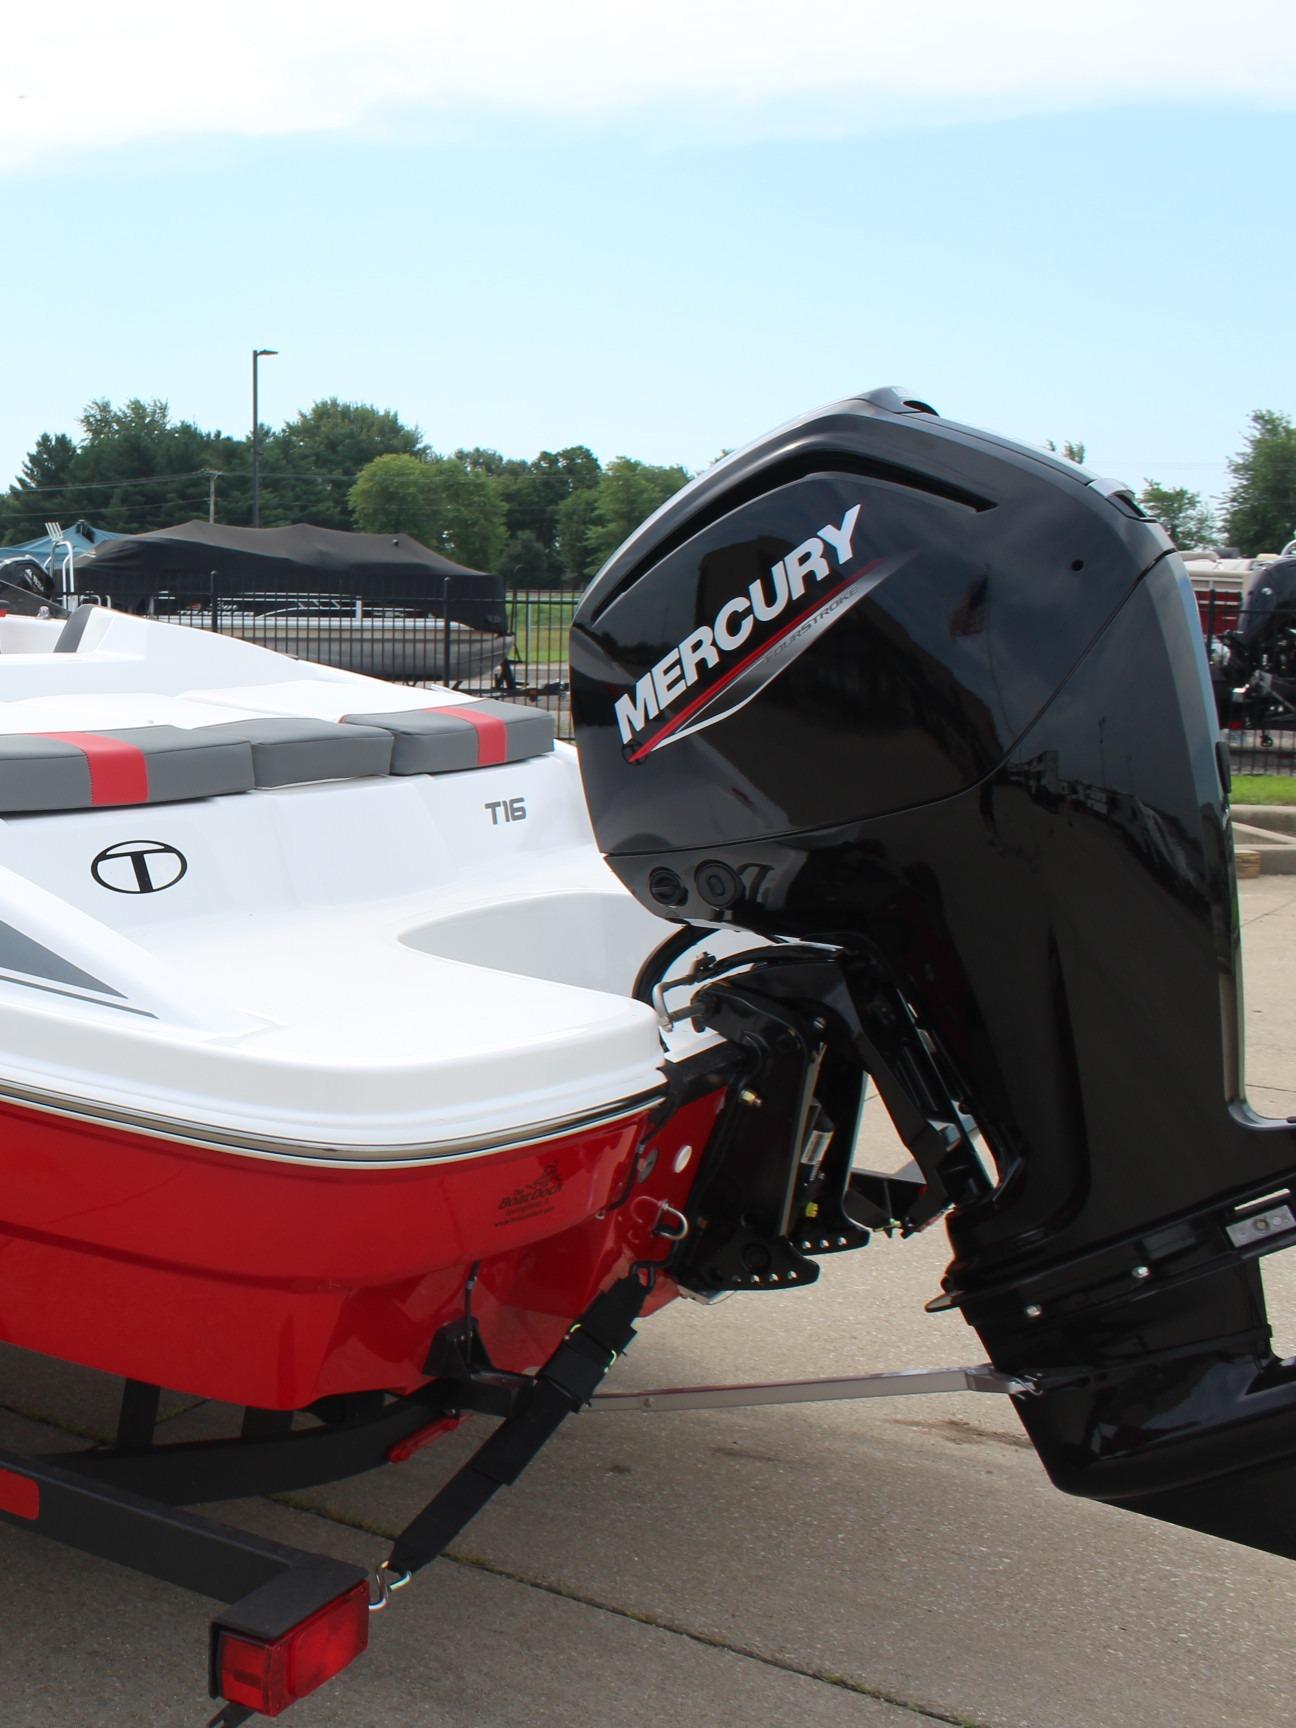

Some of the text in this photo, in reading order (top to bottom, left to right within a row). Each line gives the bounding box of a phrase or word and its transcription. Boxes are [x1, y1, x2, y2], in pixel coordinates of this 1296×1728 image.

[614, 503, 862, 744] MERCURY
[763, 584, 858, 664] FOURSTROKE
[484, 796, 527, 825] T16
